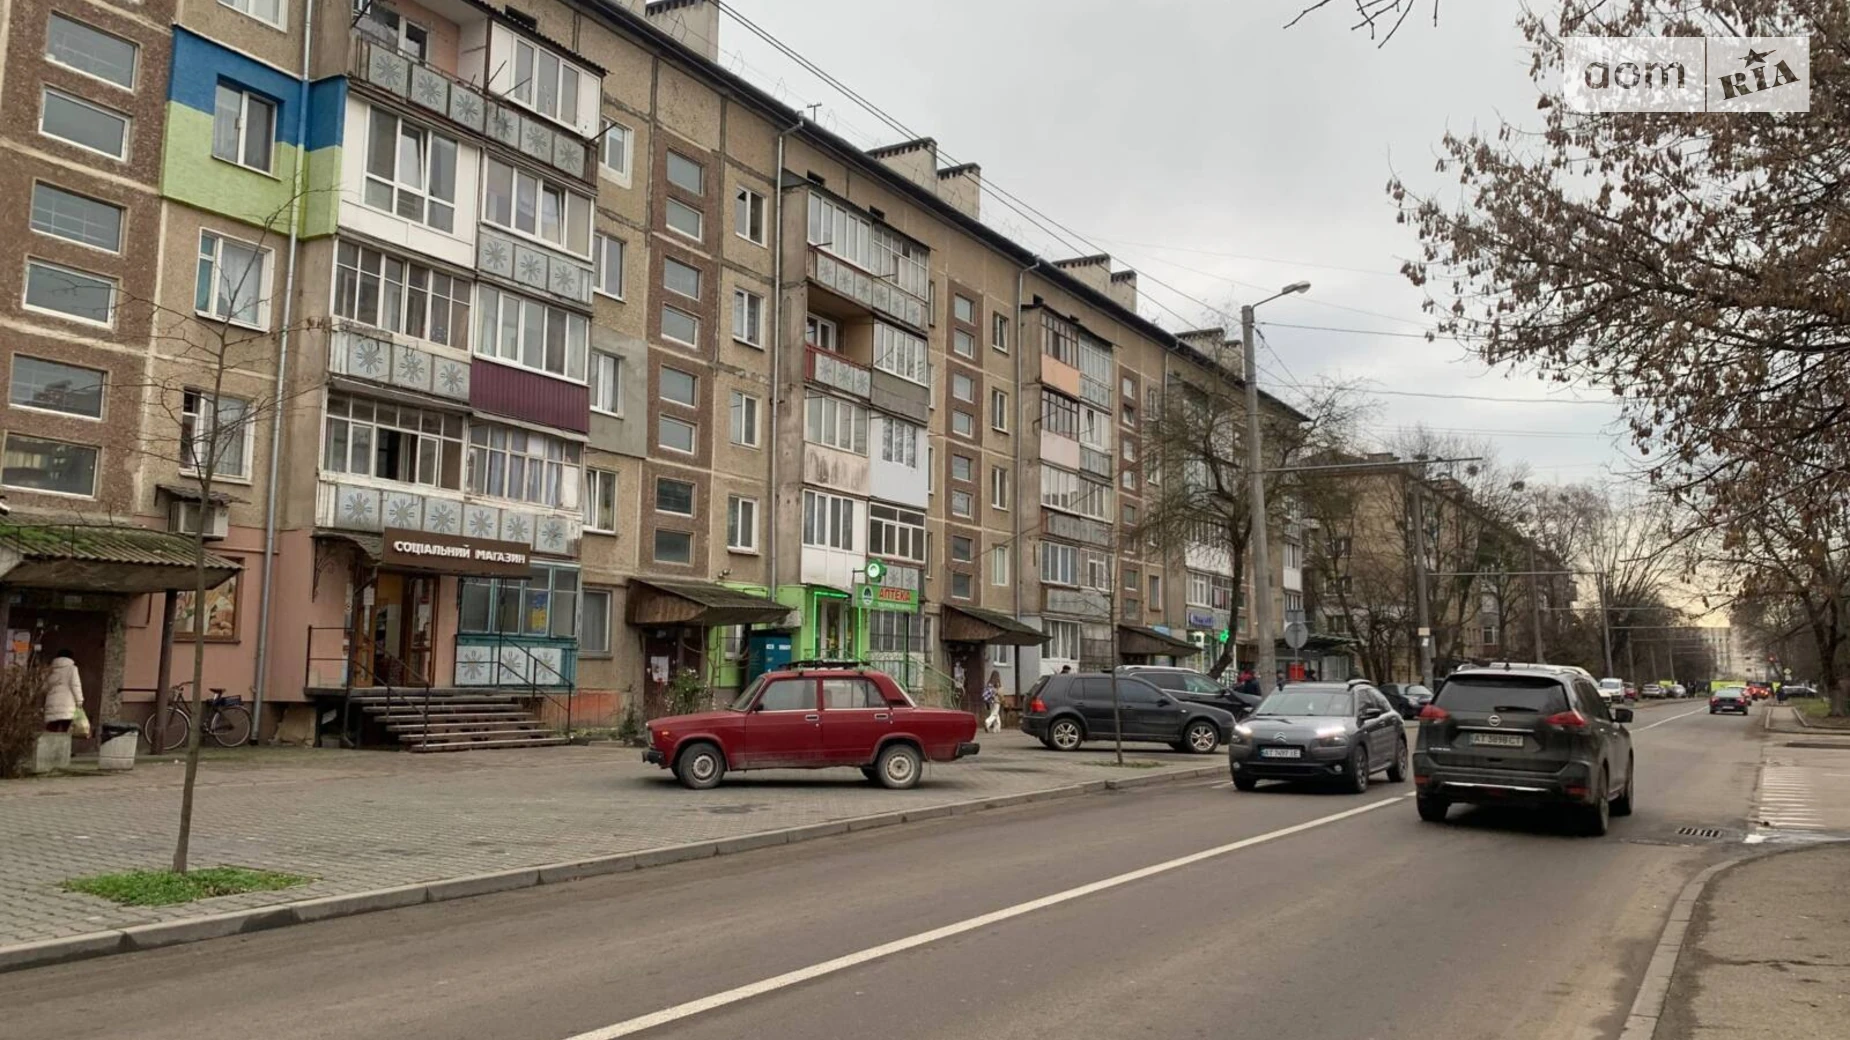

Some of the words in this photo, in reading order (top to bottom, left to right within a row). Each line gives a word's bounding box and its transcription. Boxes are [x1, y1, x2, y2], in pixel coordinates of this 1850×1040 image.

[393, 541, 470, 559] СОЦІАЛЬНИЙ
[475, 549, 526, 564] МАГАЗИН
[879, 588, 910, 601] АПТЕКА
